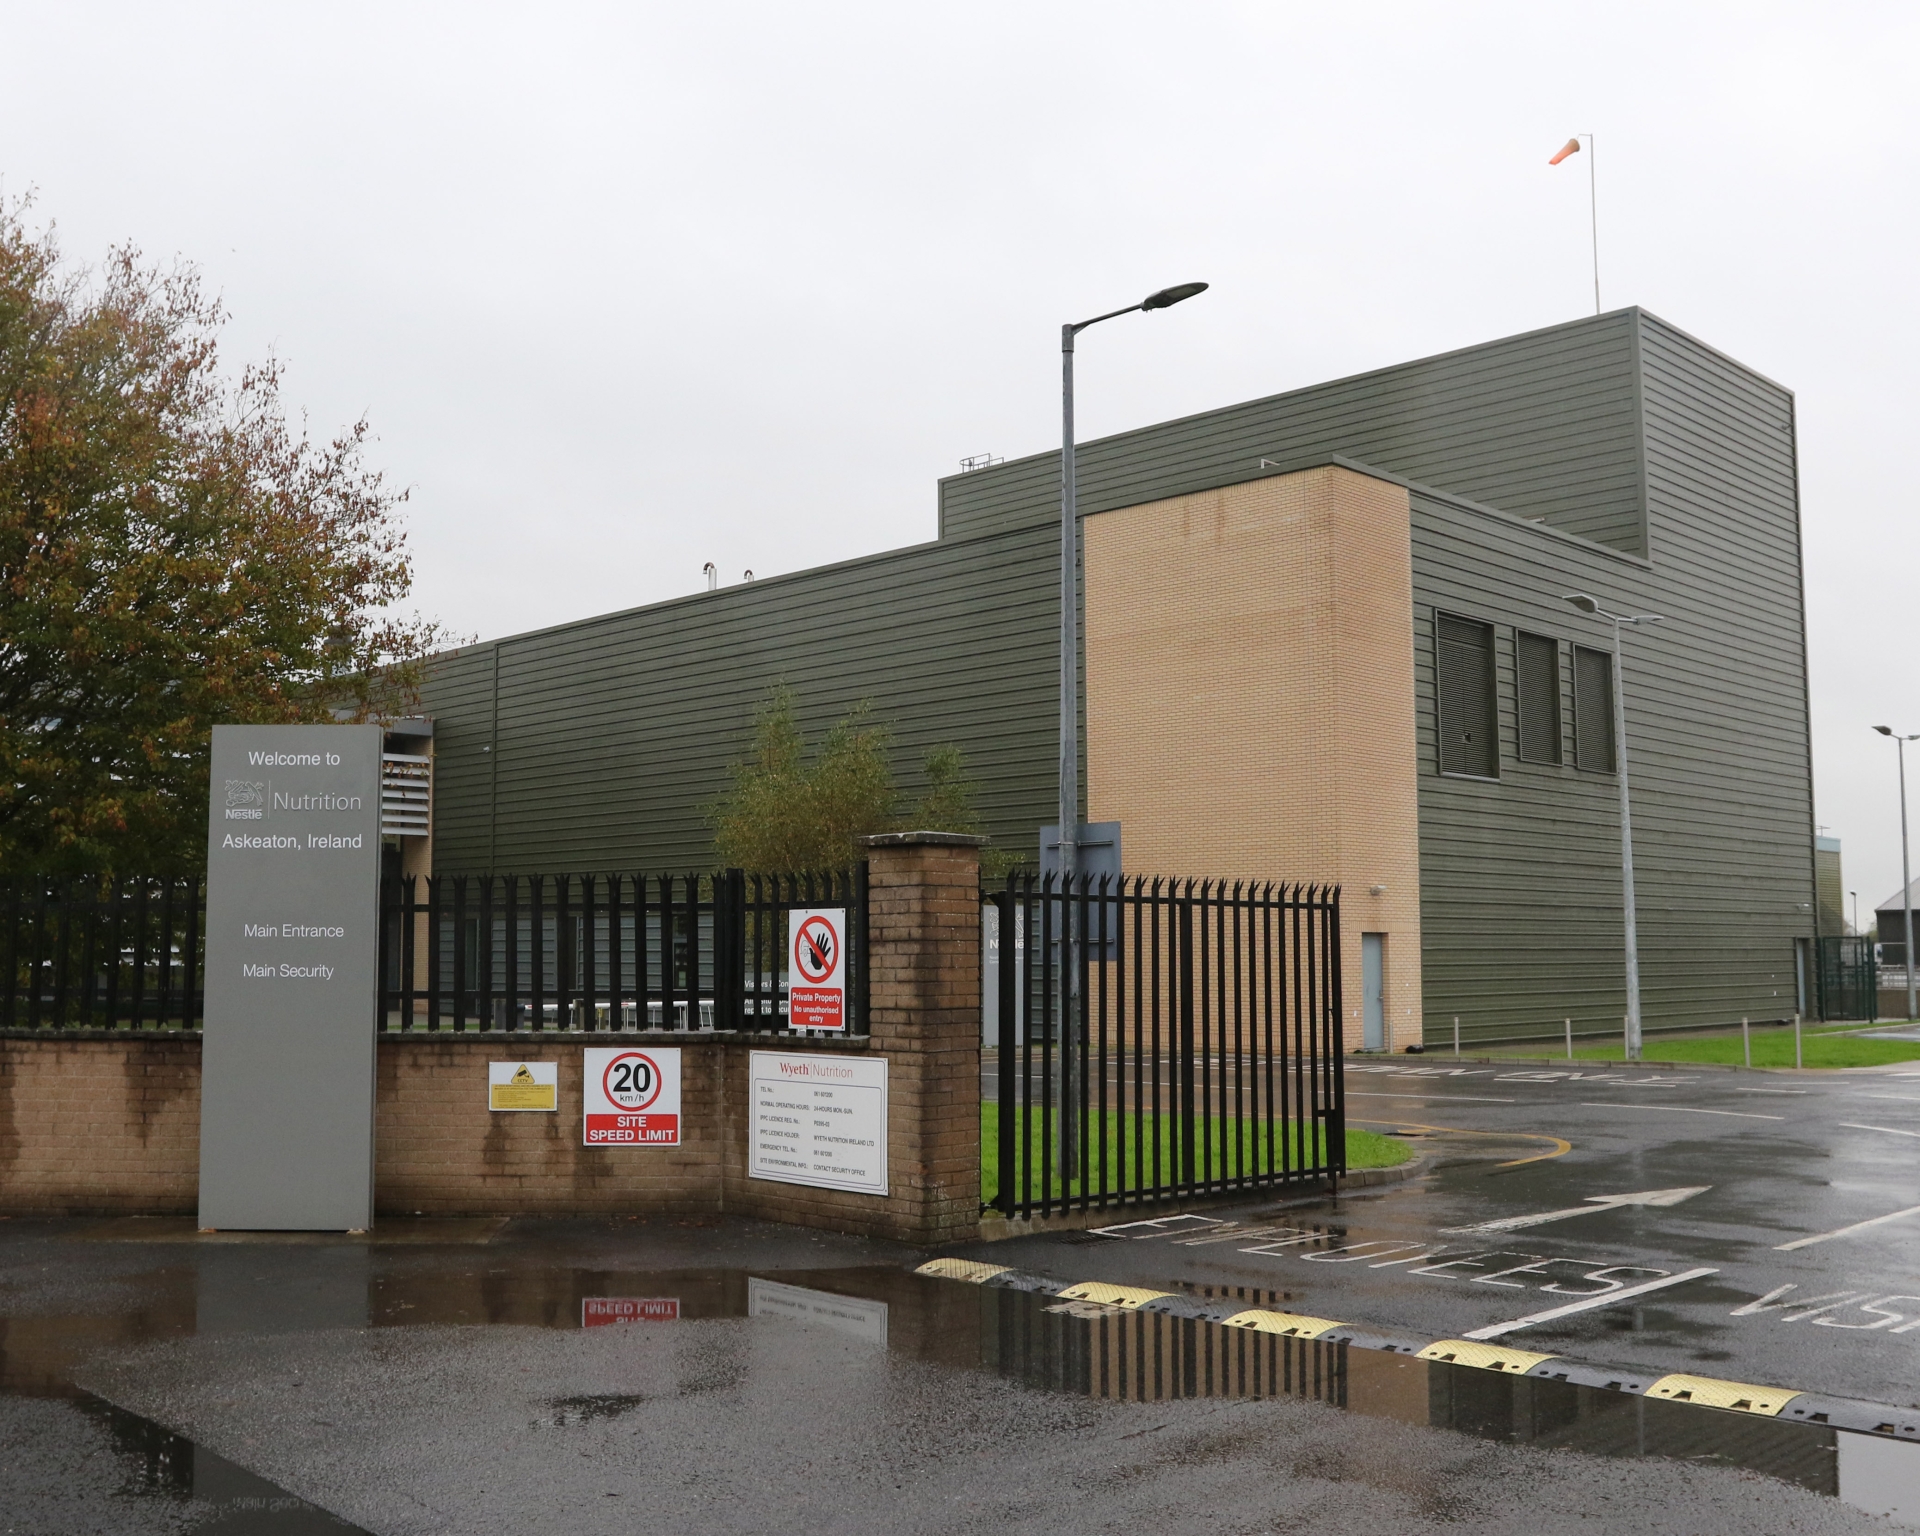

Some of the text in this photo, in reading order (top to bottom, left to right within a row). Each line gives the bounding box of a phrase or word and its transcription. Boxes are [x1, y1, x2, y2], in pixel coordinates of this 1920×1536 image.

[248, 751, 340, 766] Welcome to
[274, 792, 361, 810] Nutrition
[225, 809, 262, 820] Nestlé
[222, 833, 362, 850] Askeaton, Ireland
[244, 924, 344, 937] Main Entrance
[990, 939, 1024, 949] Nlé
[243, 964, 334, 980] Main Security
[792, 992, 841, 1004] Private Property
[794, 1005, 802, 1013] No
[803, 1006, 839, 1014] unauthorised
[809, 1015, 823, 1023] entry
[780, 1062, 809, 1077] Wyeth
[813, 1064, 853, 1078] Nutrition
[613, 1063, 650, 1092] 20
[617, 1116, 647, 1127] SITE
[589, 1130, 674, 1141] SPEED LIMIT
[832, 1166, 850, 1174] SECURITY
